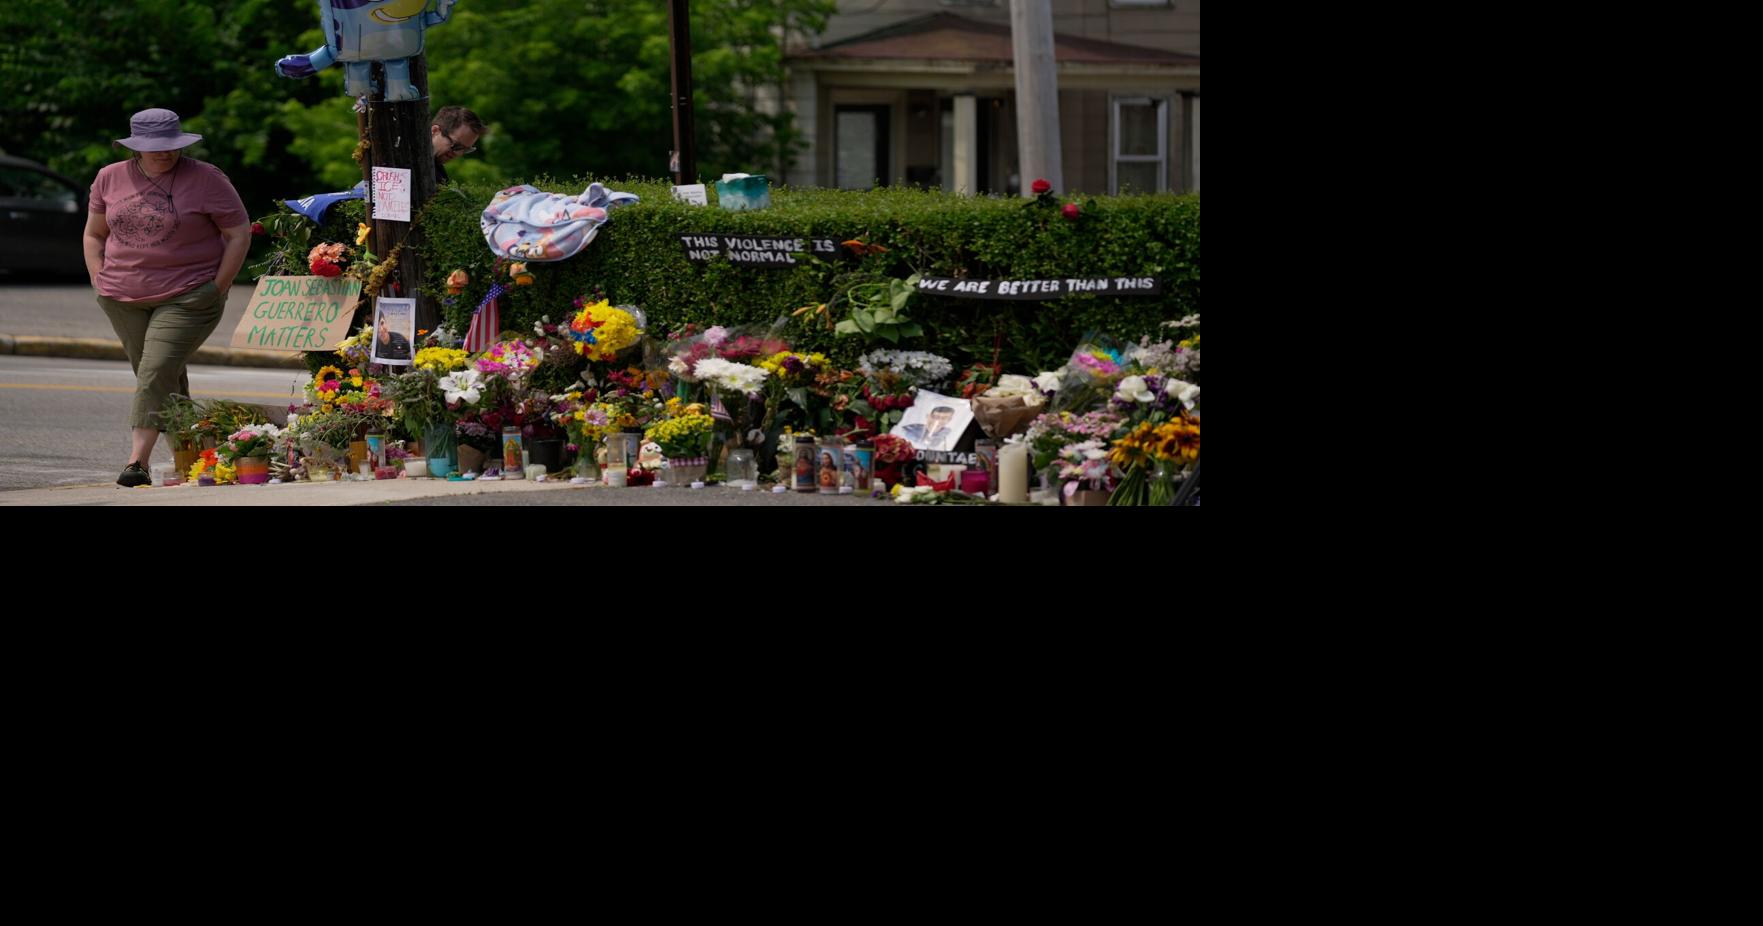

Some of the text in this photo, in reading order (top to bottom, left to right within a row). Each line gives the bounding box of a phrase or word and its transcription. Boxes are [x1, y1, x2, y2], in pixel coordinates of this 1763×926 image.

[681, 236, 835, 252] THIS VIOLENCE IS
[688, 250, 796, 263] NOT NORMAL
[260, 279, 301, 297] JOAN
[919, 277, 1154, 295] WE ARE BETTER THAN THIS
[253, 301, 340, 323] GUERRERO
[247, 325, 329, 348] MATTERS
